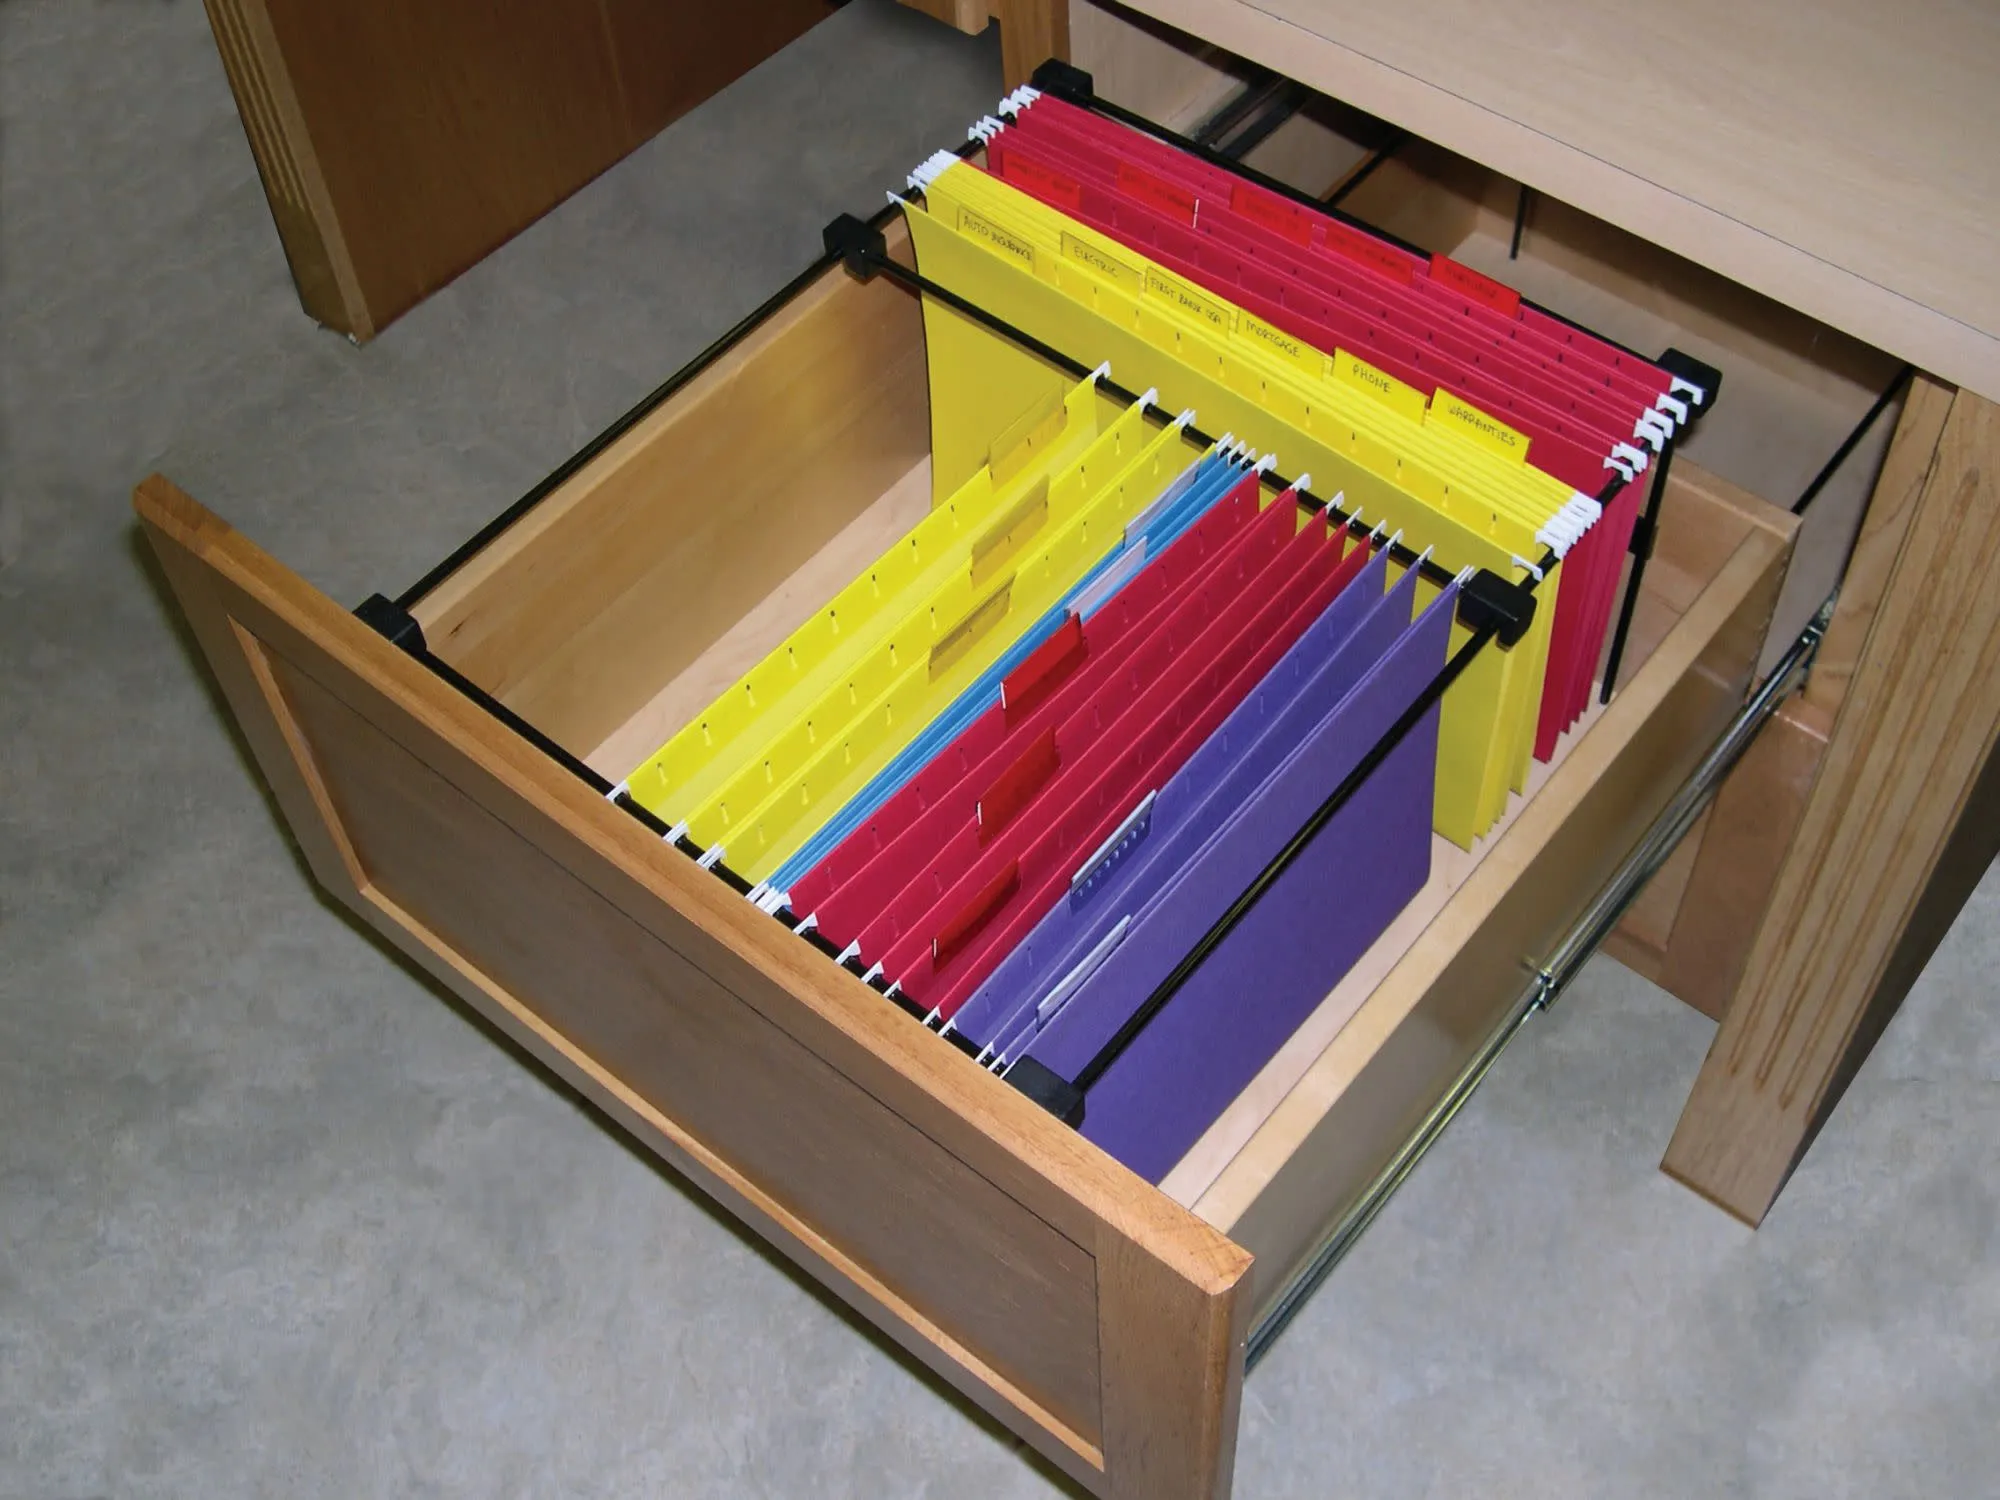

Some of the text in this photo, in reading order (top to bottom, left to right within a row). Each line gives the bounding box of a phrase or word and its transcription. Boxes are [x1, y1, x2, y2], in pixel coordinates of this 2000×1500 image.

[964, 215, 989, 236] AUTO
[1150, 277, 1176, 298] FIRST
[1246, 319, 1301, 359] MORTGAGE
[1352, 363, 1392, 394] PHONE
[1447, 404, 1516, 447] WARRANTIES
